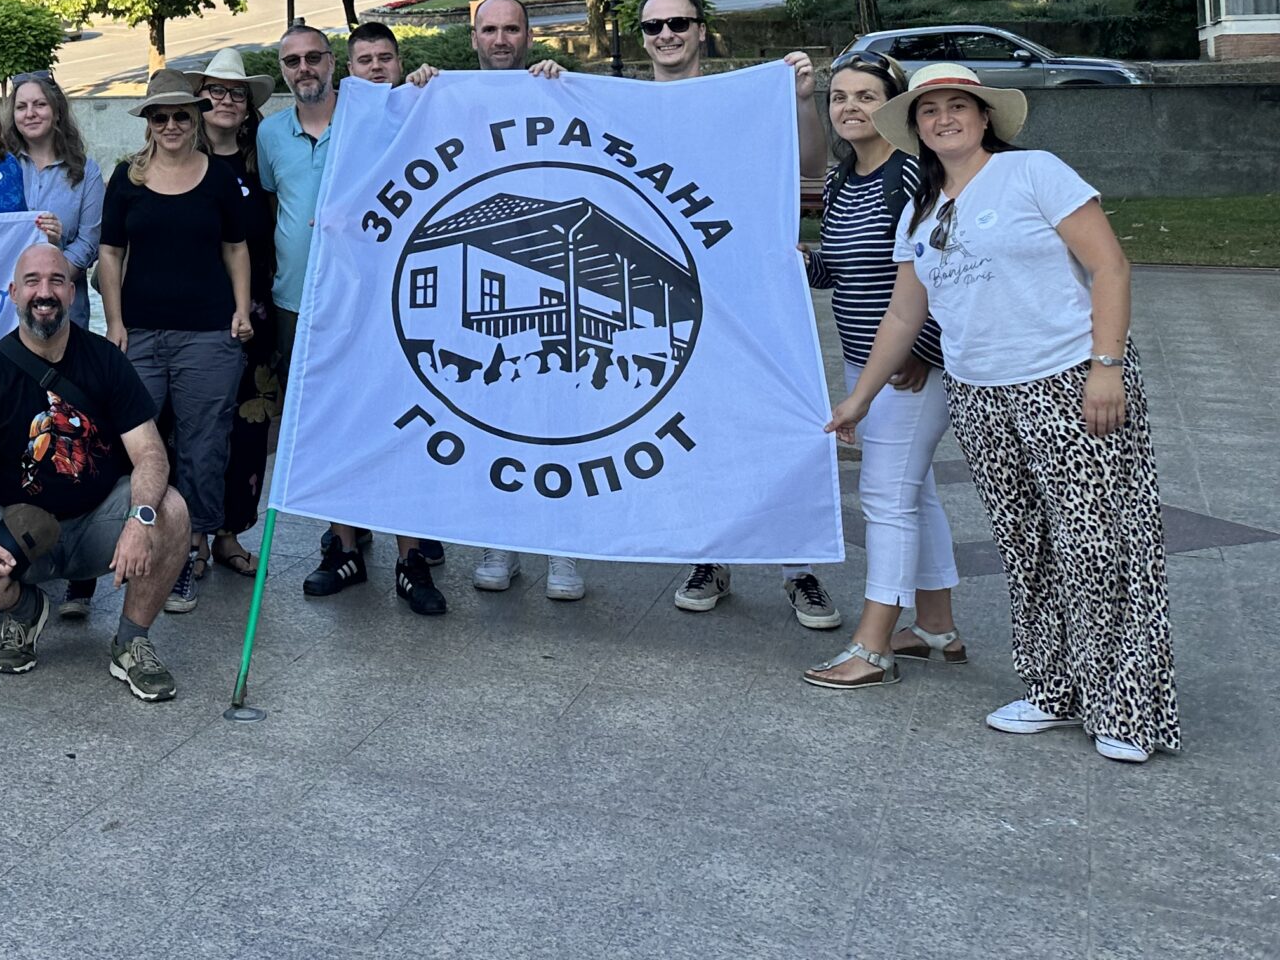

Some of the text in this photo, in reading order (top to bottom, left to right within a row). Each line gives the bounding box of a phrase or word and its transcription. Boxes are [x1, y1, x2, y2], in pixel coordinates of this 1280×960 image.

[361, 116, 734, 250] ЗБОР ГРАЂАНА
[929, 258, 993, 288] Bonjour
[393, 404, 697, 499] ГО СОПОТ
